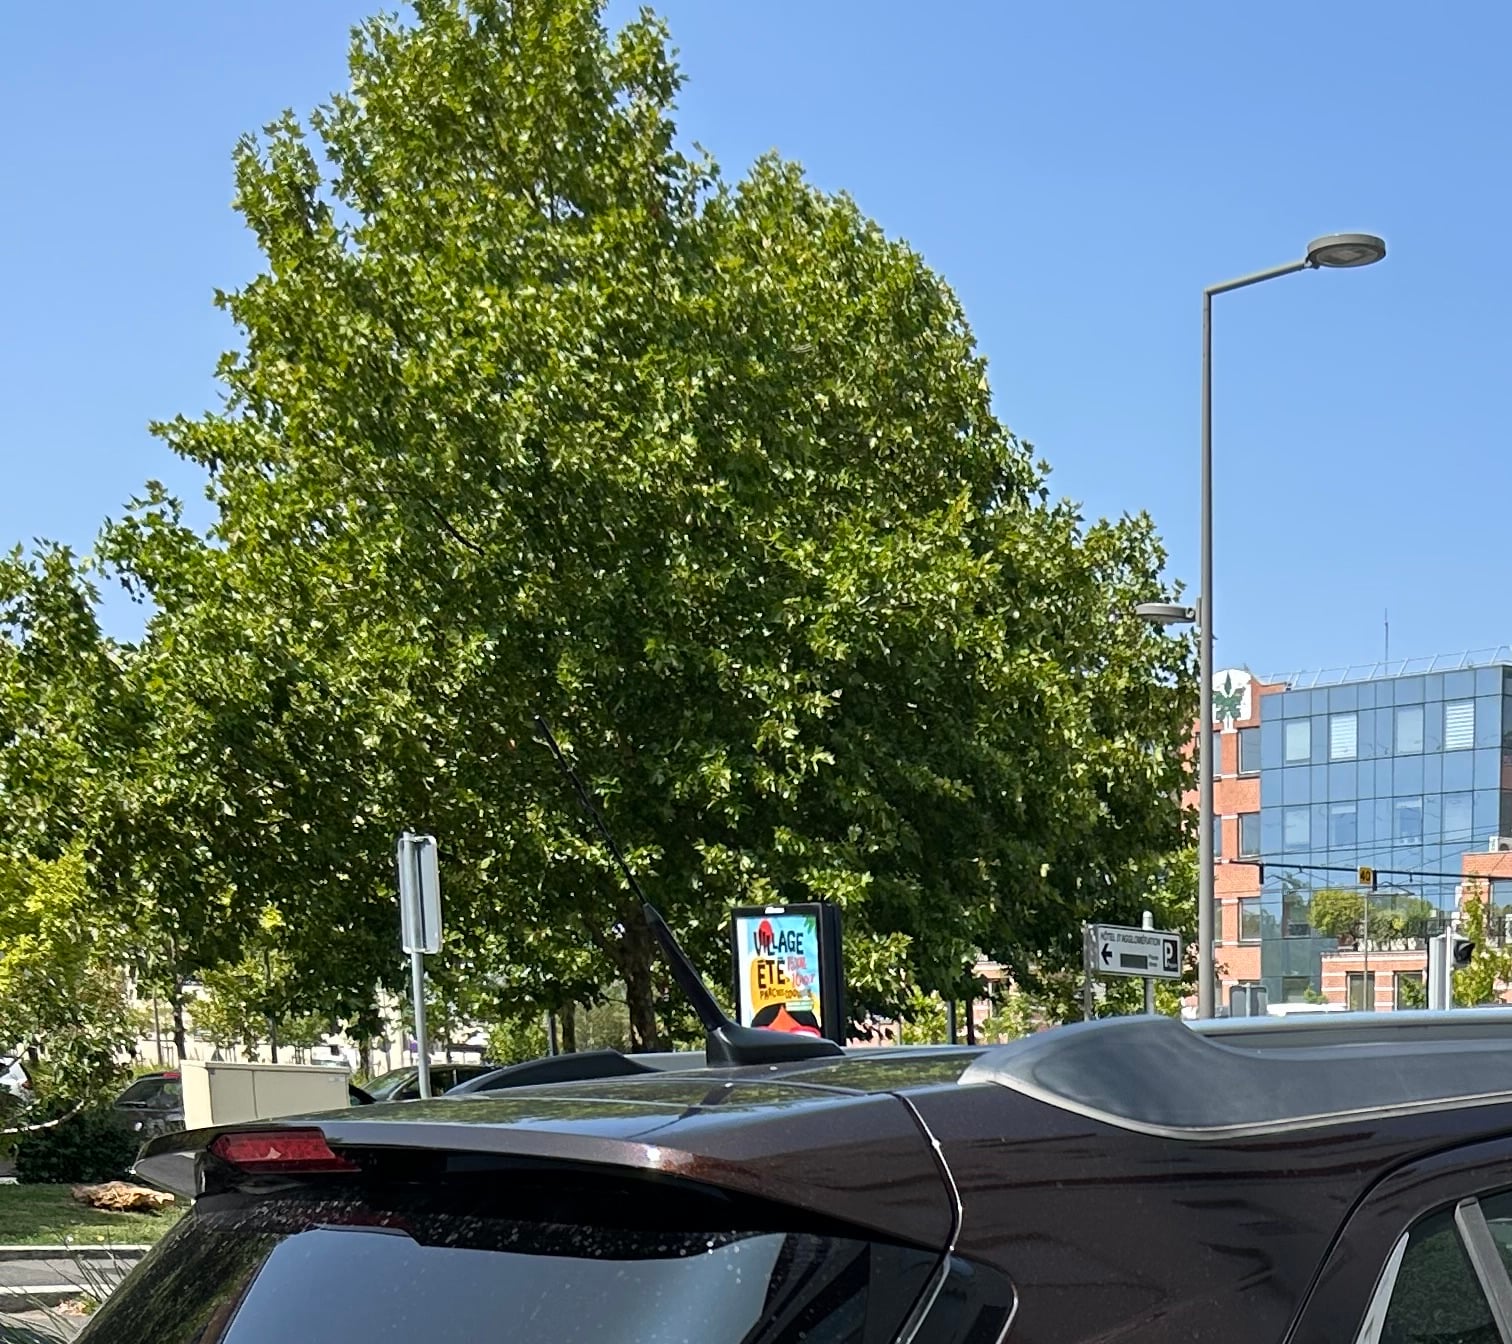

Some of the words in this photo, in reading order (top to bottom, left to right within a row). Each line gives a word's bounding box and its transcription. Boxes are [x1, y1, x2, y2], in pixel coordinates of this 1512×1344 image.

[753, 930, 804, 956] VILLAGE
[1164, 942, 1173, 968] P
[757, 957, 786, 989] ÉTÉ
